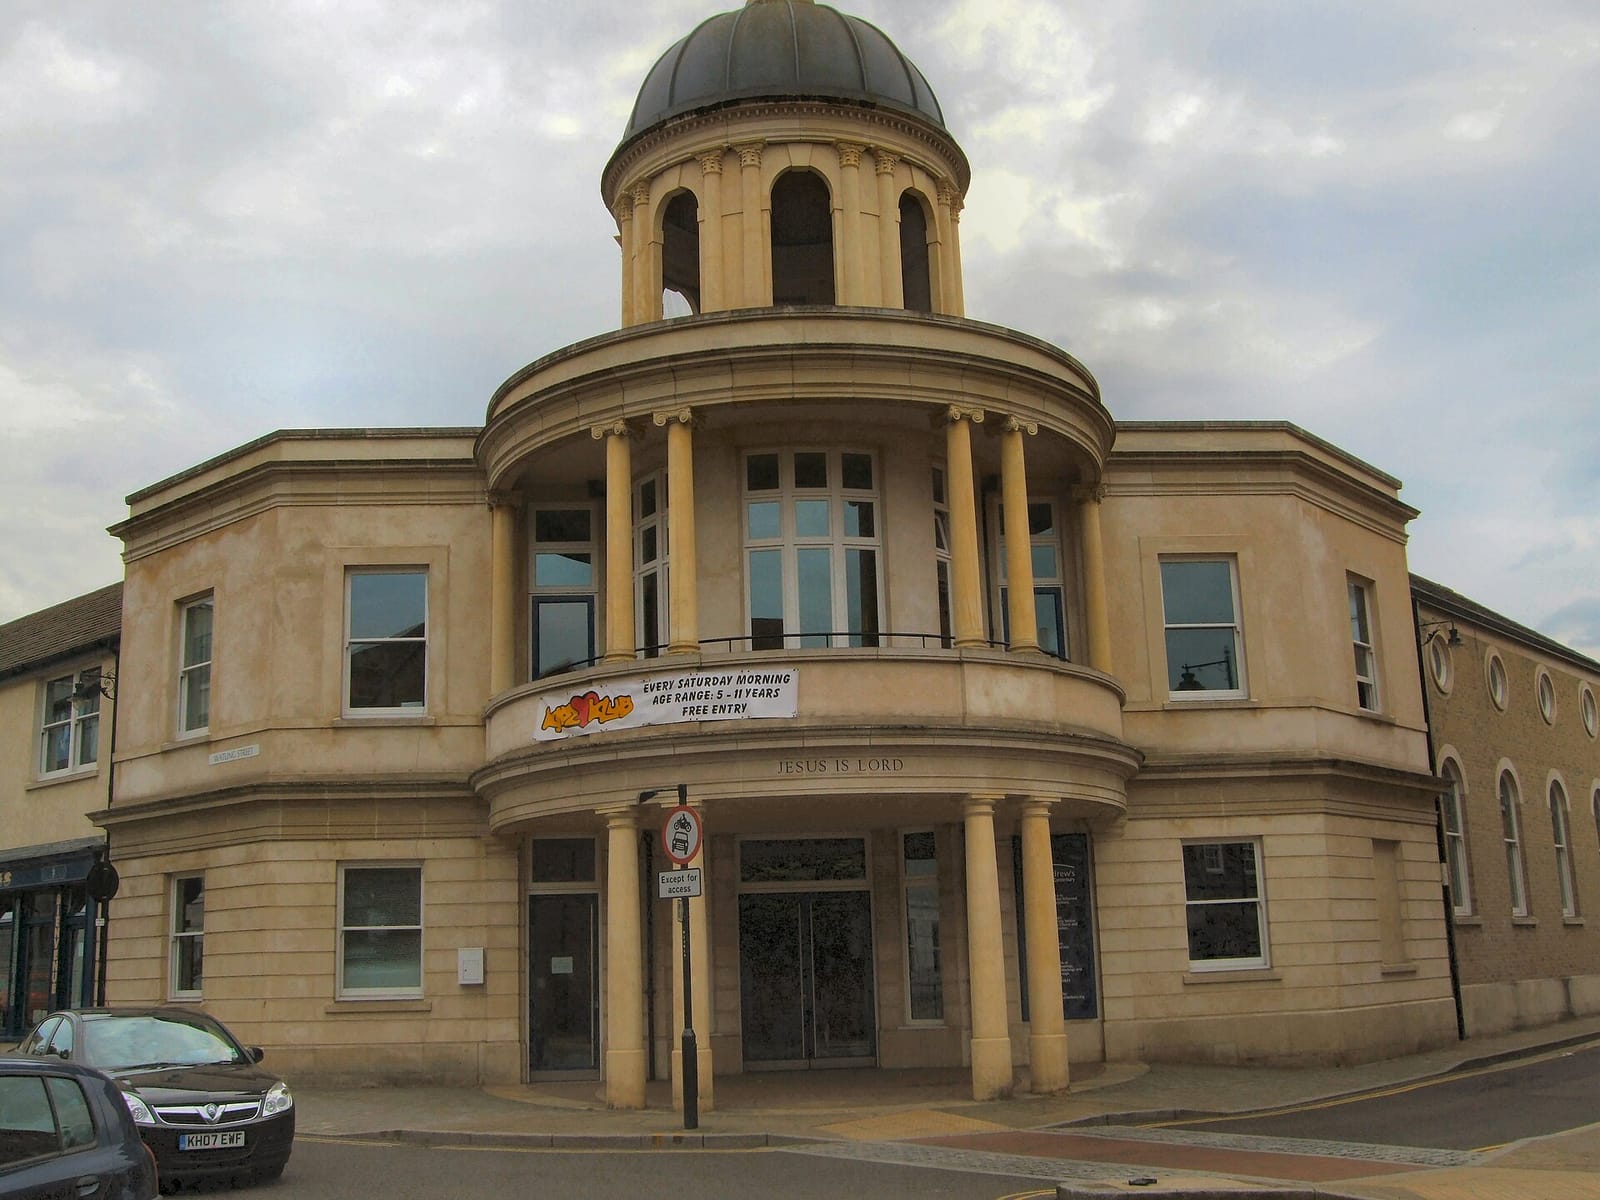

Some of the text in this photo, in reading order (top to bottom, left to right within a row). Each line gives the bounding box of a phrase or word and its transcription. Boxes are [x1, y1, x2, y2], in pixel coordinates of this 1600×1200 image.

[643, 674, 791, 693] EVERY SATURDAY MORNING
[652, 694, 673, 705] AGE
[674, 690, 714, 703] RANGE:
[716, 690, 724, 700] 5
[734, 689, 743, 699] 11
[745, 688, 780, 699] YEARS
[682, 703, 748, 716] FREE ENTRY
[778, 759, 904, 774] JESUS IS LORD
[661, 874, 697, 884] Except for
[668, 885, 691, 894] access
[187, 1132, 243, 1147] KH07 EWF
